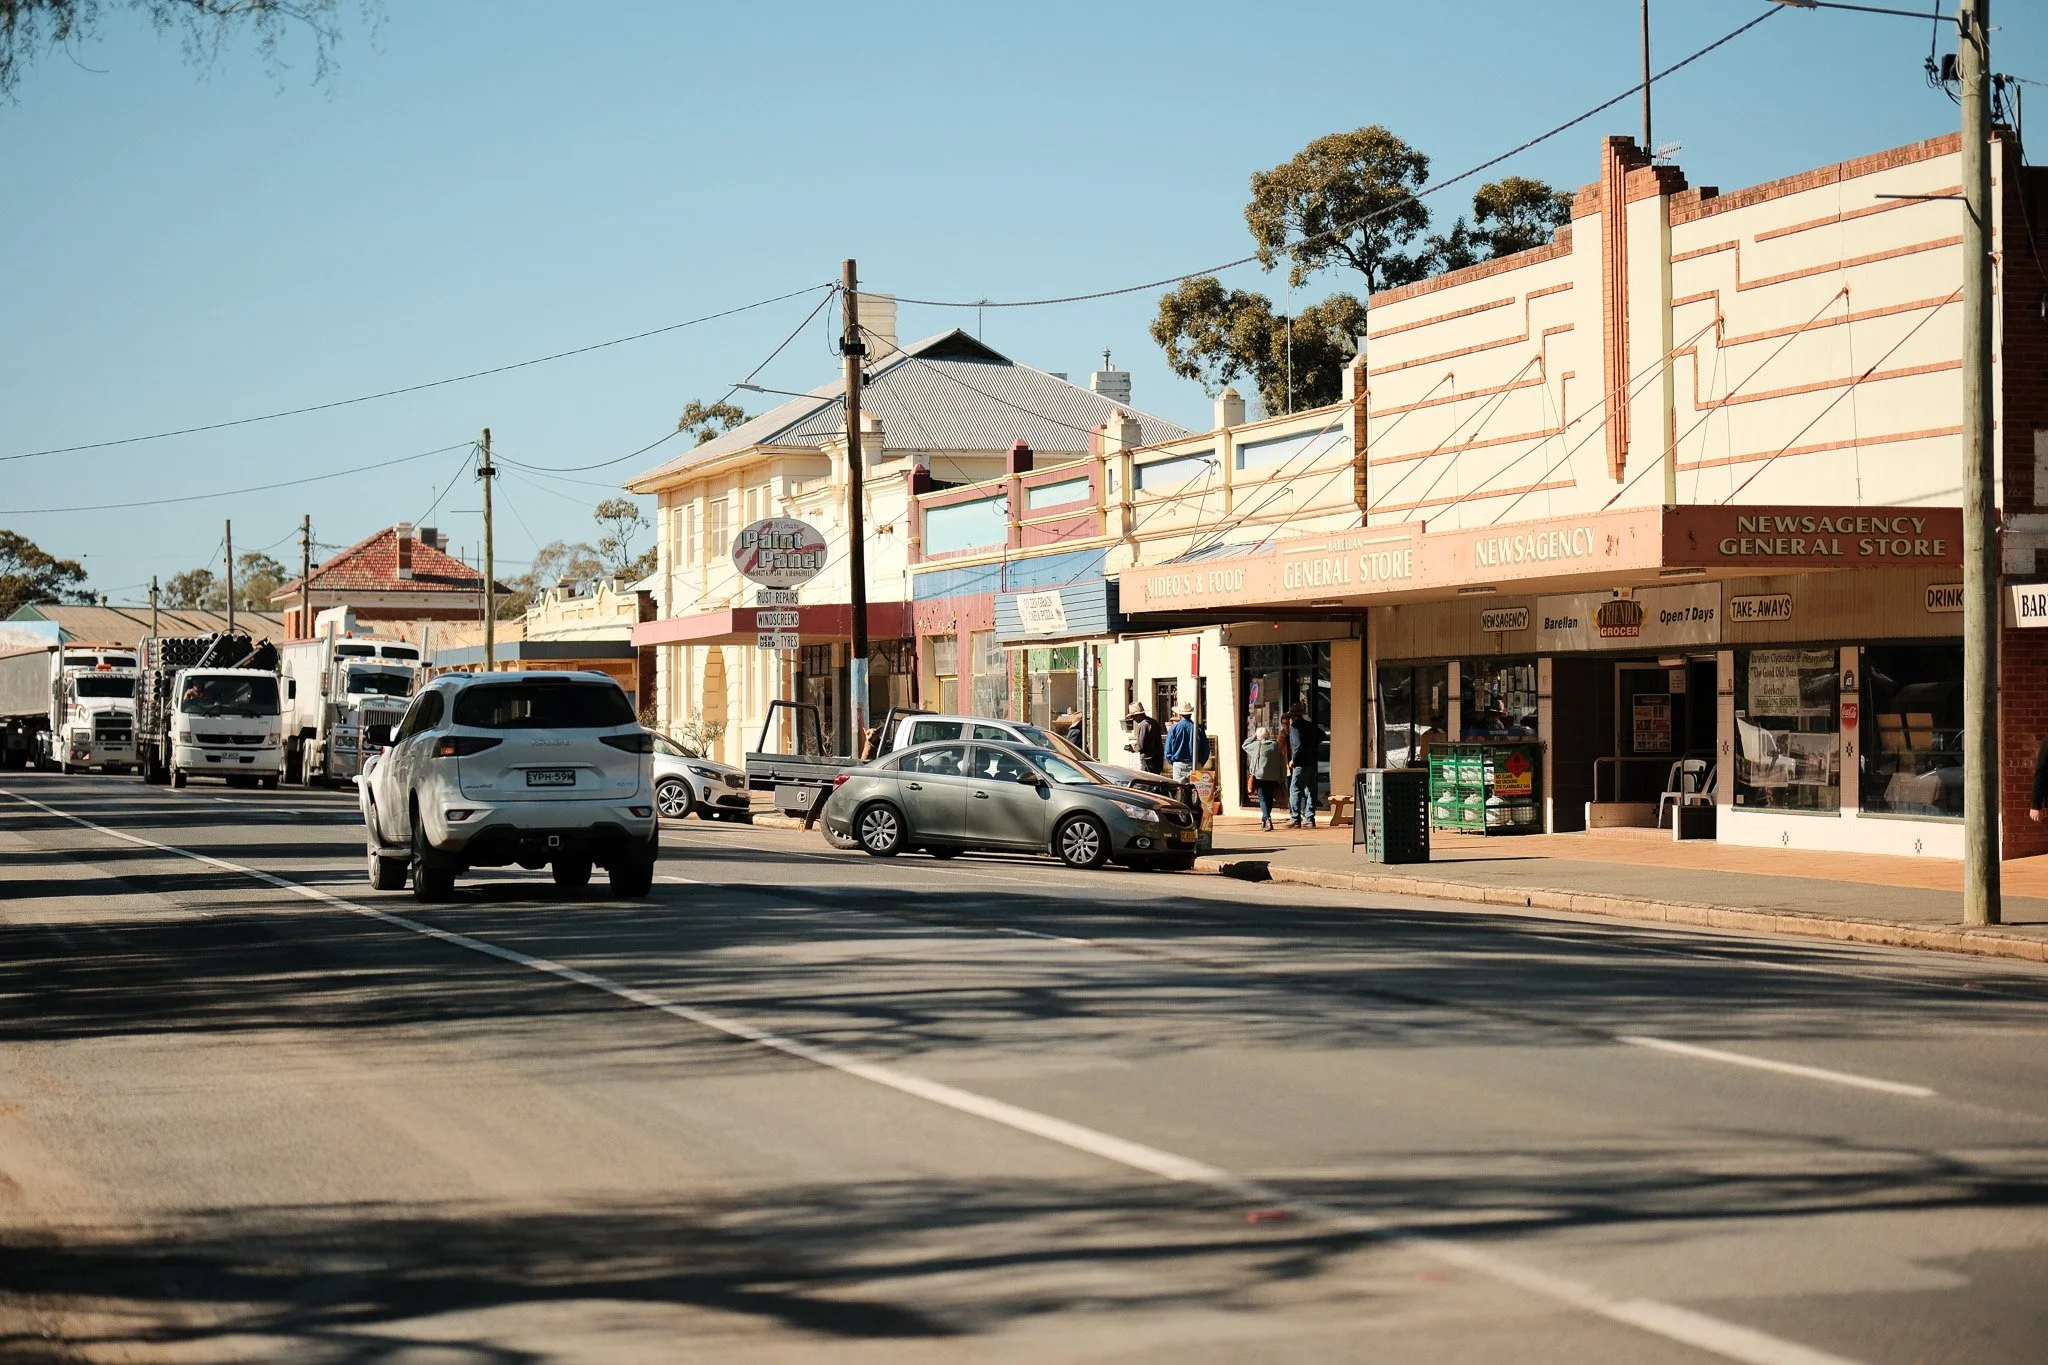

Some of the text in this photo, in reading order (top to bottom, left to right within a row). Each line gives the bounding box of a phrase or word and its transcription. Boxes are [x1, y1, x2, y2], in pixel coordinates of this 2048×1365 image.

[1737, 516, 1926, 534] NEWSAGENCY
[742, 530, 803, 549] Paint
[1328, 538, 1363, 552] BARELLAN
[1475, 527, 1596, 568] NEWSAGENCY
[1719, 538, 1946, 557] GENERAL STORE
[758, 550, 822, 569] Panel
[1283, 549, 1412, 590] GENERAL STORE
[1147, 568, 1243, 598] VIDEO'S & FOOD
[758, 592, 798, 604] RUST REPAIRS
[1928, 588, 1964, 608] DRINK
[2022, 594, 2048, 617] BAR
[1600, 602, 1640, 625] FRIENDLY
[1660, 608, 1714, 624] Open 7 Days
[1732, 598, 1790, 618] TAKE-AWAYS
[758, 614, 798, 626] WINDSCREENS
[1482, 611, 1527, 628] NEWSAGENCY
[1544, 617, 1578, 630] Barellan
[1600, 626, 1638, 636] GROCER
[781, 636, 797, 647] TYRES
